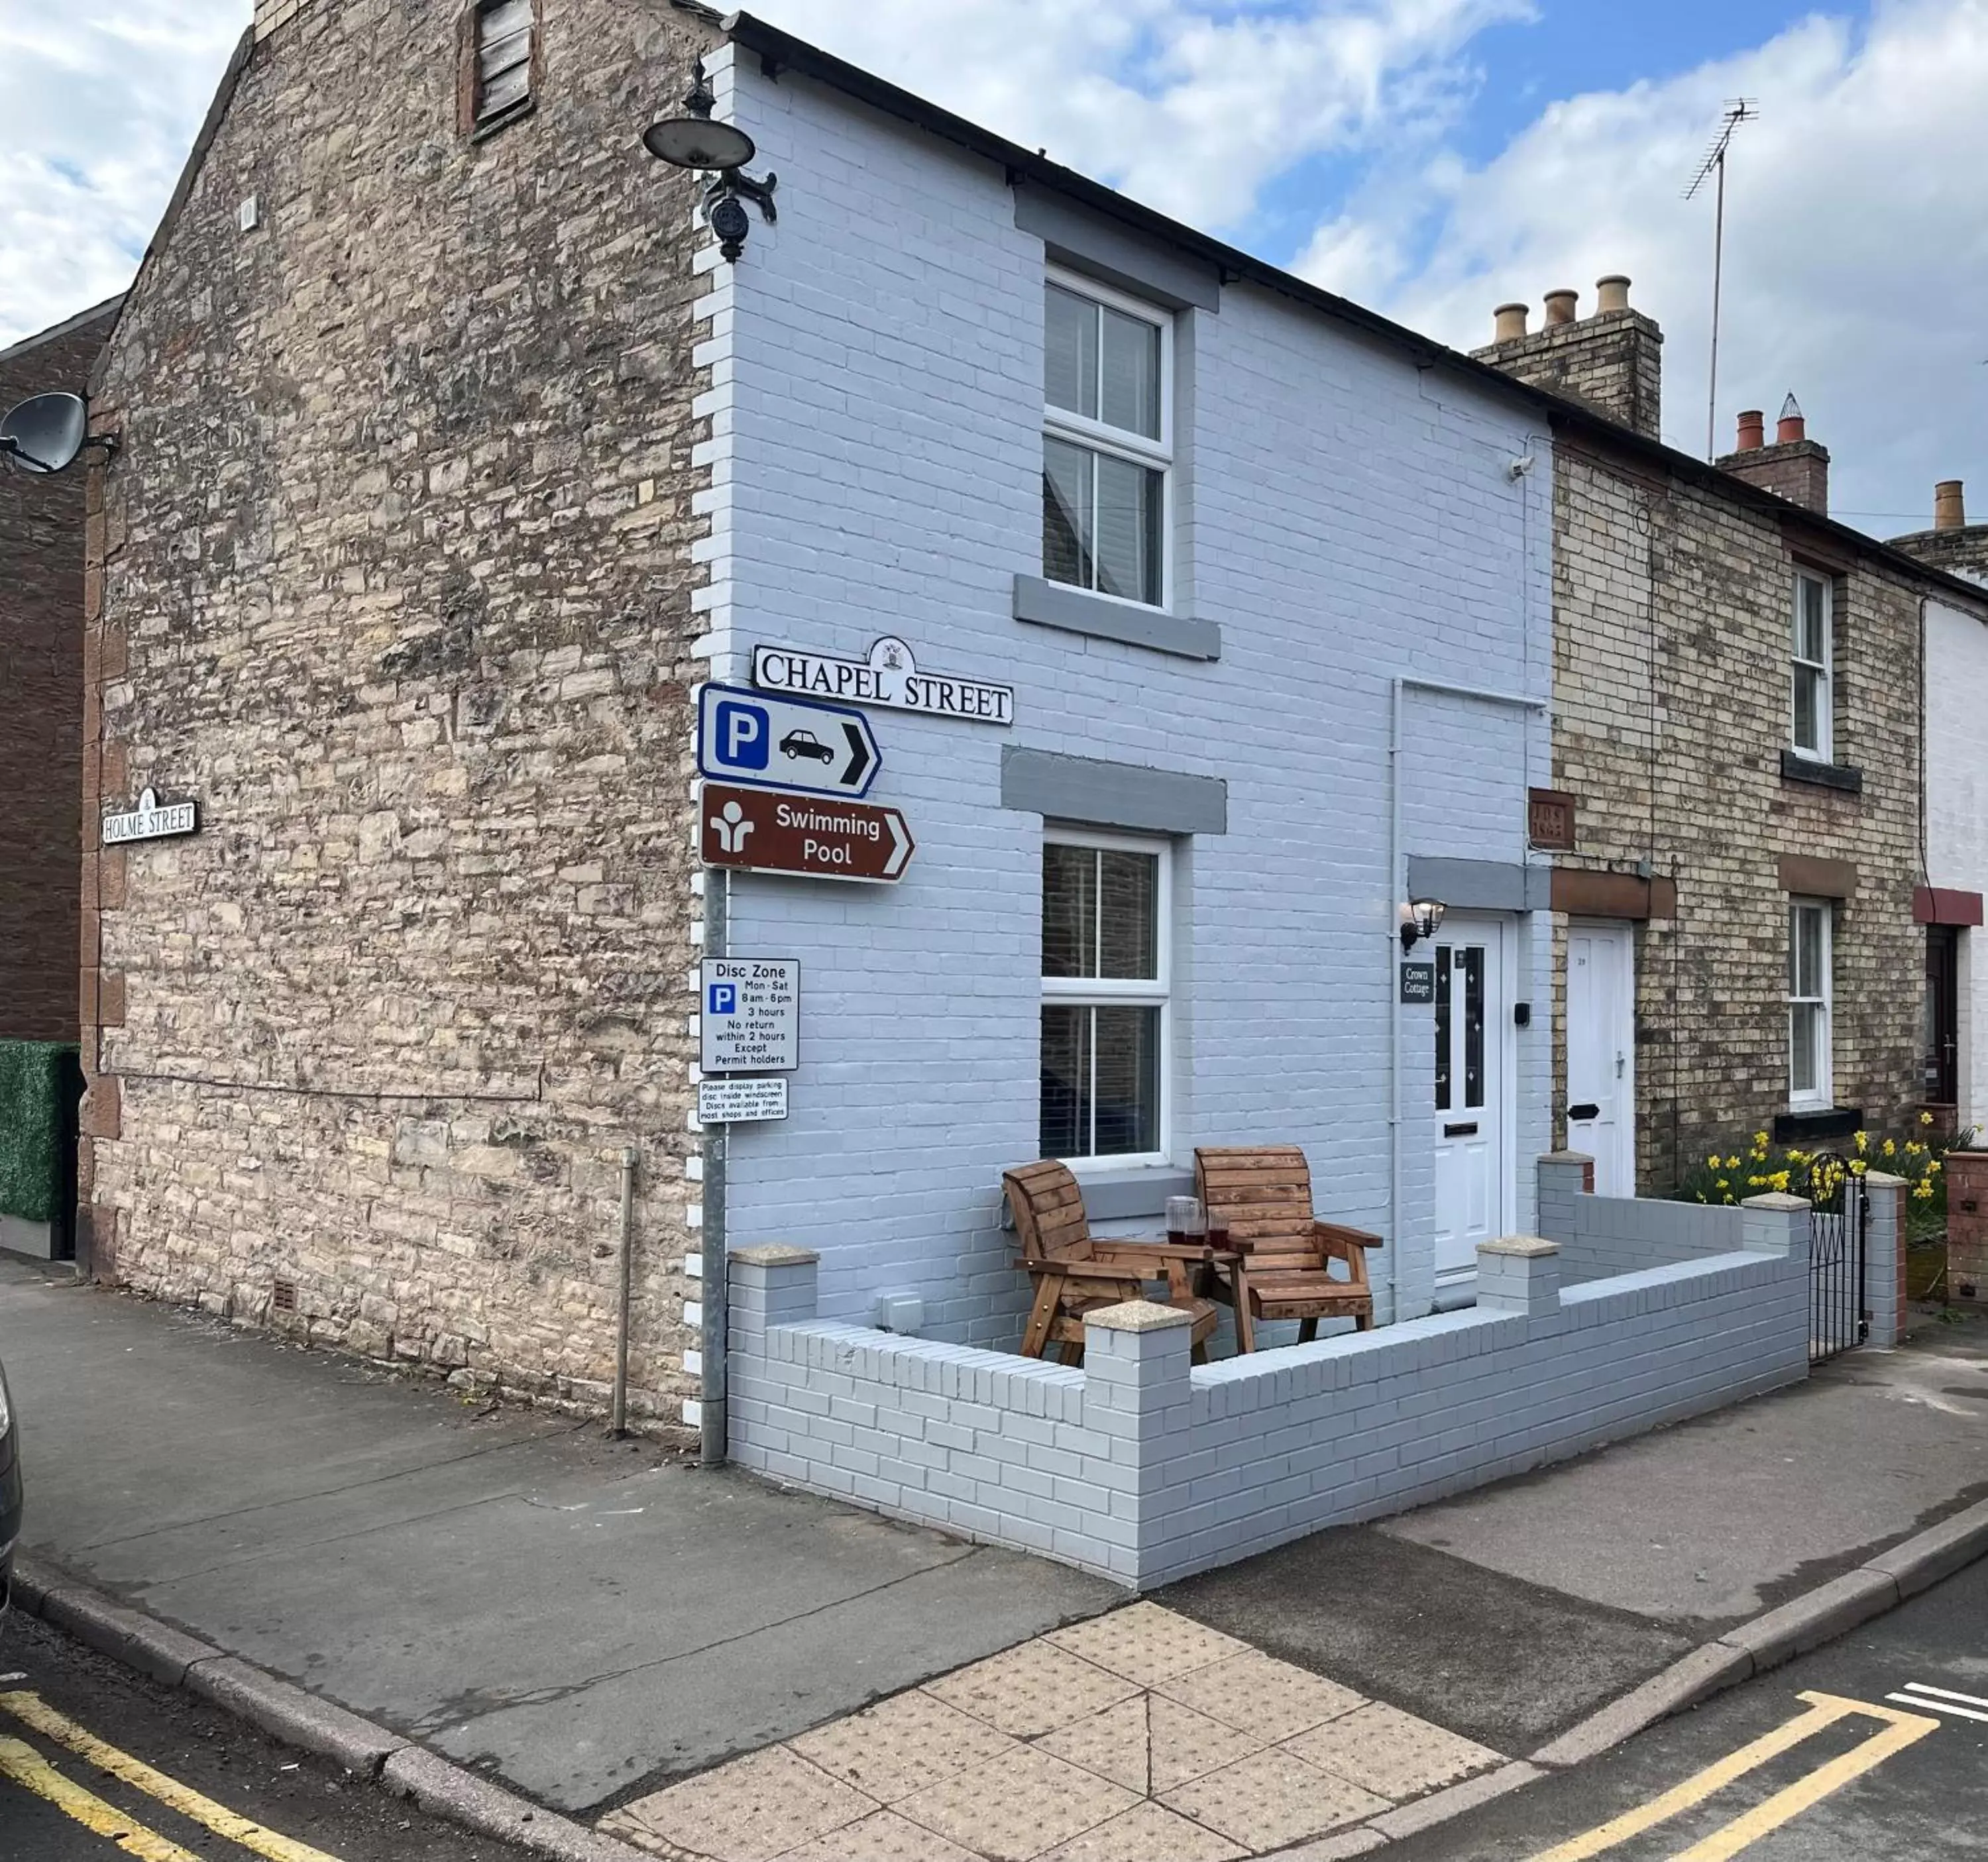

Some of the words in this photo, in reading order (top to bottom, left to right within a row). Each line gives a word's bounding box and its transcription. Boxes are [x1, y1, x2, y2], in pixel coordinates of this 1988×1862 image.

[762, 653, 891, 700] CHAPEL
[905, 677, 1009, 719] STREET
[728, 710, 758, 758] P
[105, 814, 144, 840] HOLME
[148, 805, 193, 833] STREET
[776, 804, 880, 841] Swimming
[803, 840, 852, 865] Pool
[716, 963, 747, 977] Disc
[752, 964, 786, 978] Zone
[1406, 967, 1428, 980] Crown
[1404, 981, 1429, 997] Cottage
[715, 987, 732, 1011] P
[747, 1007, 755, 1016] 3
[759, 1007, 785, 1016] hours
[727, 1020, 742, 1029] No
[746, 1020, 775, 1029] return
[716, 1032, 746, 1041] within
[749, 1031, 755, 1040] 2
[759, 1032, 785, 1040] hours
[735, 1043, 767, 1054] Except
[715, 1056, 747, 1065] Permit
[751, 1055, 785, 1064] holders
[756, 1081, 783, 1090] parking
